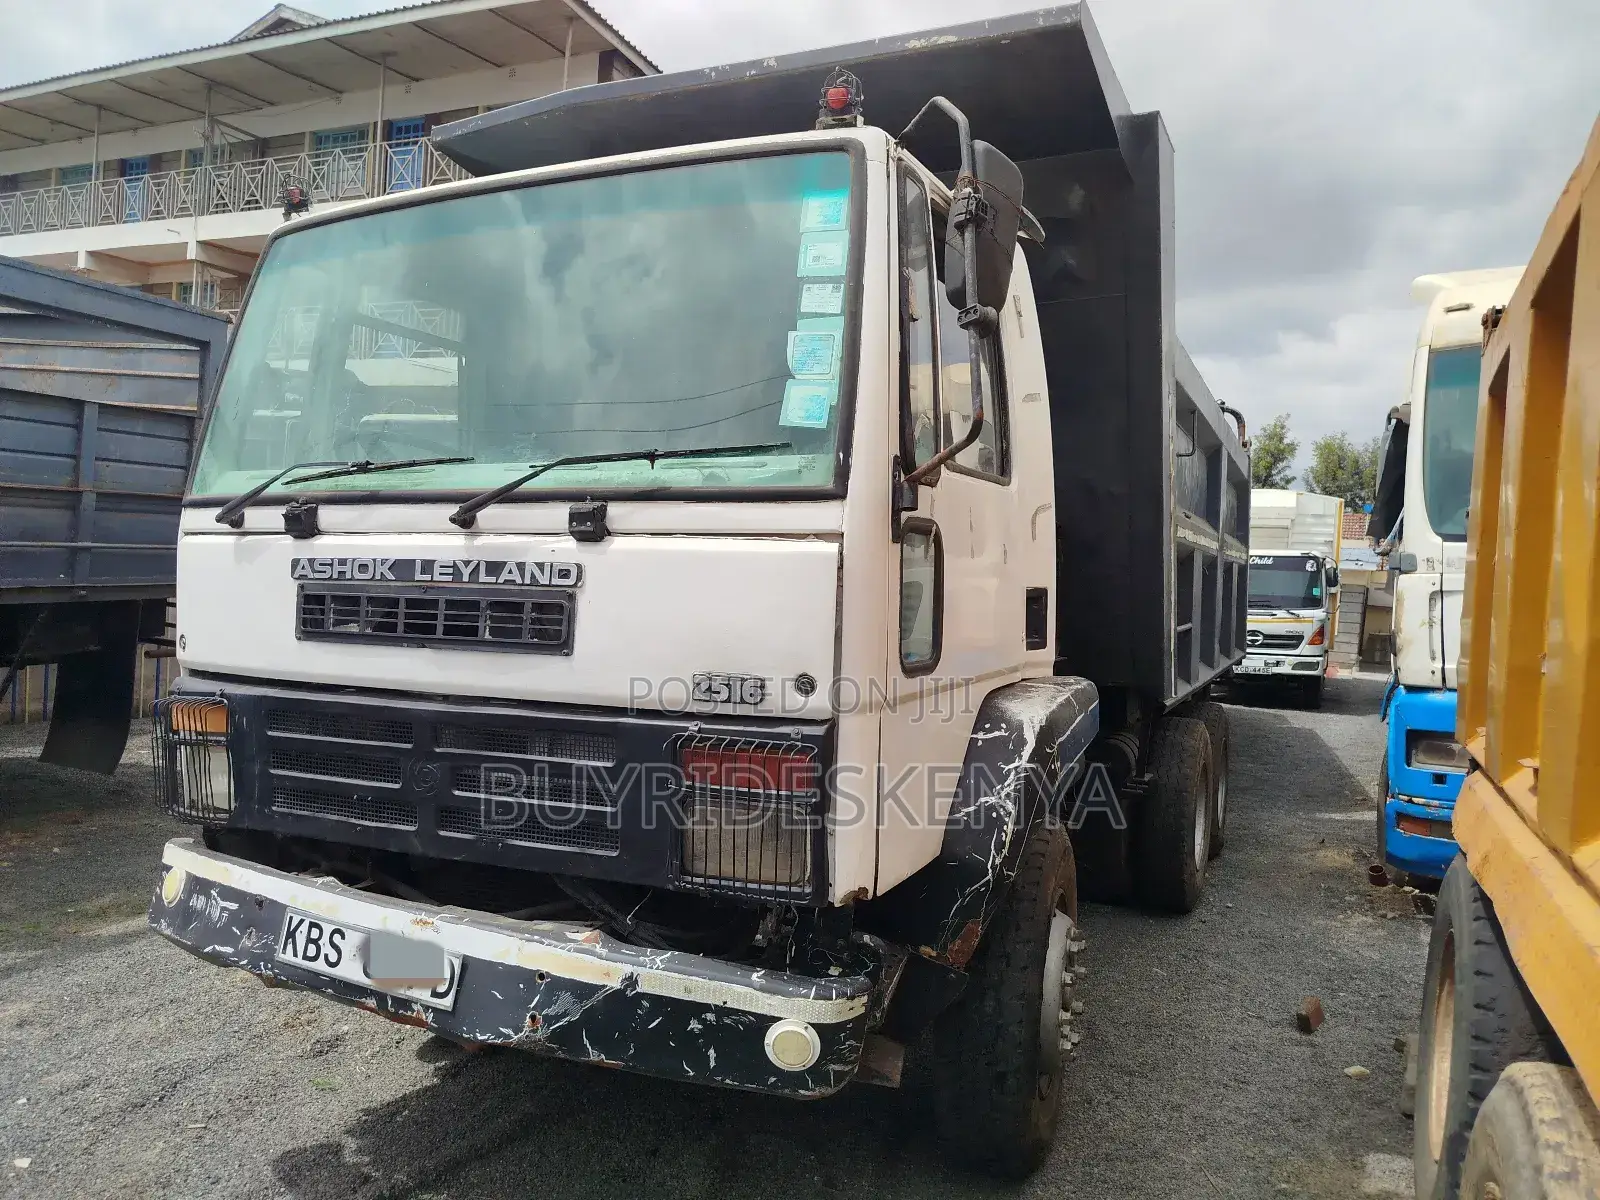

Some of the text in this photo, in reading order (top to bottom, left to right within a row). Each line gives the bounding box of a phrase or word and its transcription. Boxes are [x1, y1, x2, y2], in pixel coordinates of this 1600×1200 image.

[291, 557, 579, 586] ASHOK LEYLAND
[1249, 556, 1274, 565] Child
[692, 673, 765, 705] 2516
[280, 915, 346, 969] KBS
